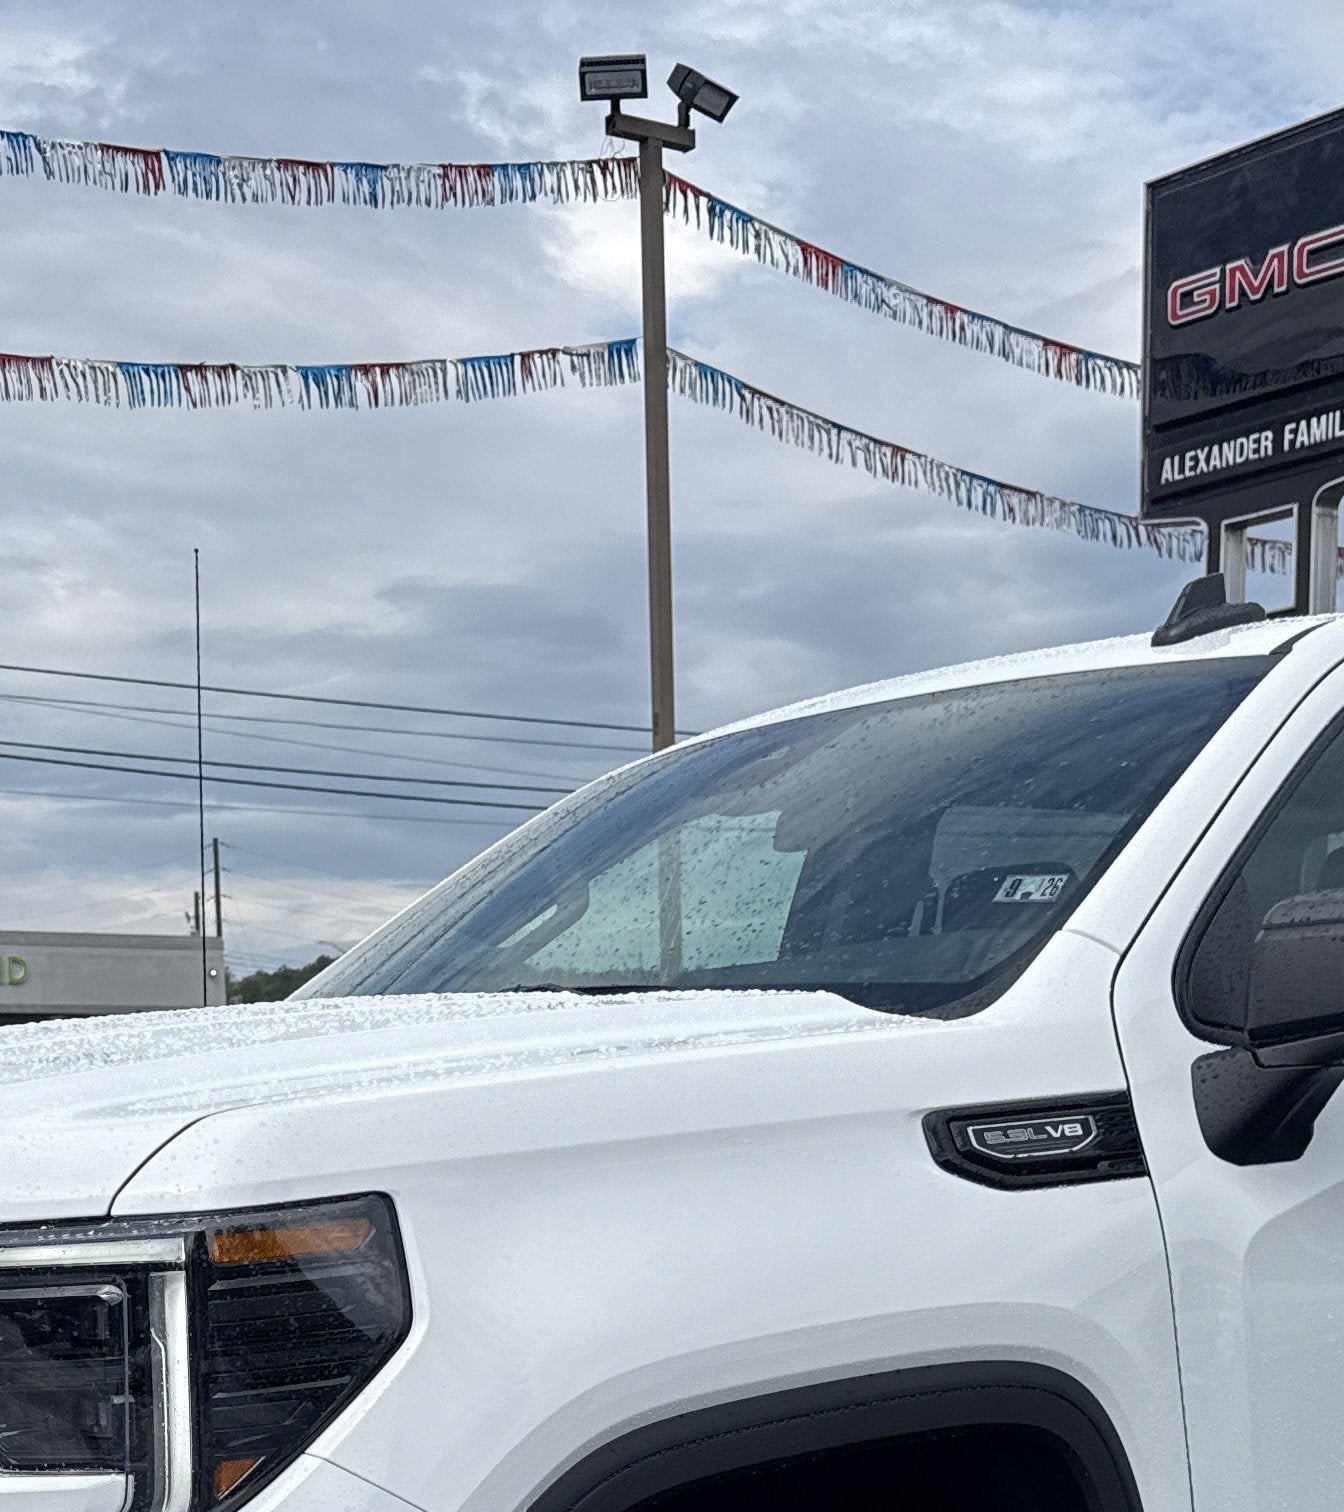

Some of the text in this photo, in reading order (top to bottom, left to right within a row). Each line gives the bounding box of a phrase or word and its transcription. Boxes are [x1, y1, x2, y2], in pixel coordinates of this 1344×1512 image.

[1160, 431, 1273, 485] ALEXANDER
[1040, 877, 1064, 897] 26
[1044, 1122, 1084, 1138] V8
